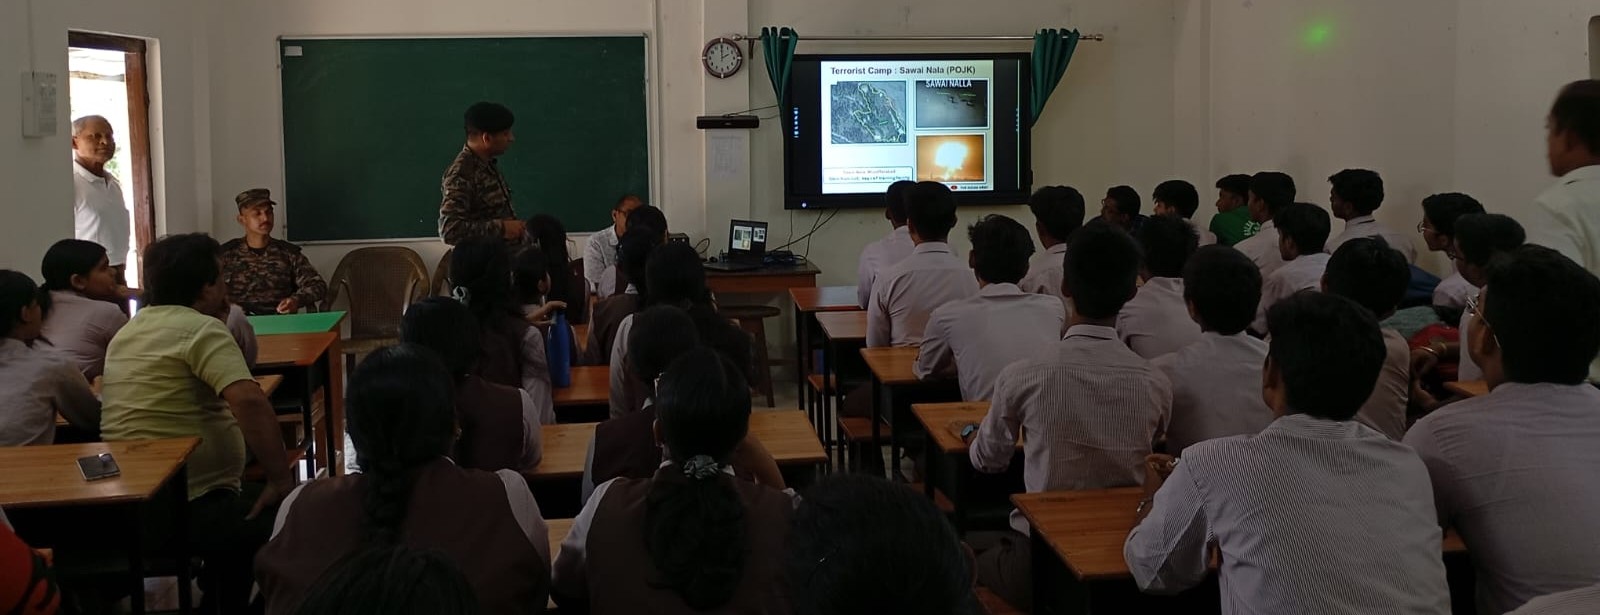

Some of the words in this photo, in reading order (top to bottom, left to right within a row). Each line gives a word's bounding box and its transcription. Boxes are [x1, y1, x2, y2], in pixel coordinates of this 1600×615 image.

[831, 67, 866, 75] Terrorist
[868, 66, 892, 76] Camp
[899, 66, 924, 74] Sawai
[927, 66, 944, 74] Nala
[946, 65, 976, 75] (POJK)
[949, 79, 972, 88] NALLA
